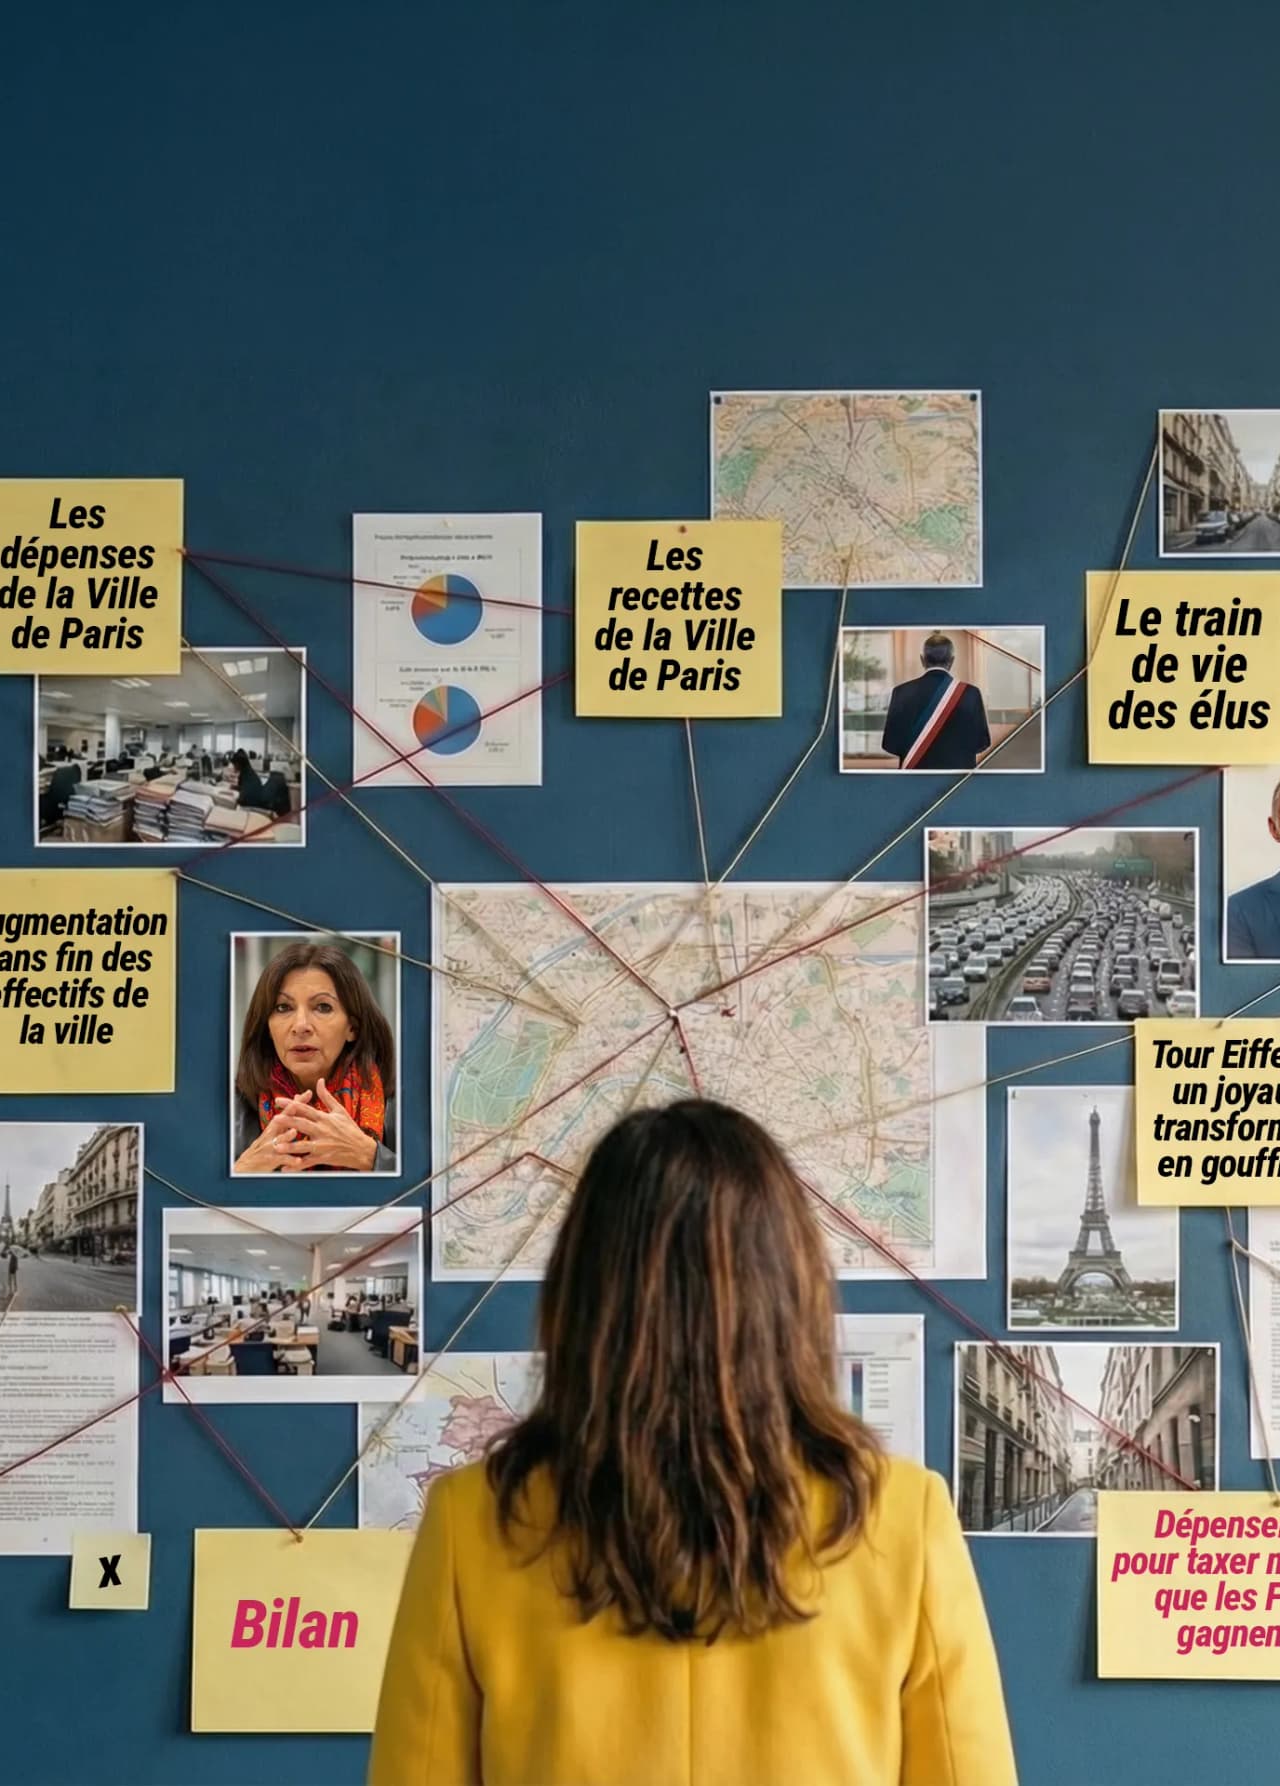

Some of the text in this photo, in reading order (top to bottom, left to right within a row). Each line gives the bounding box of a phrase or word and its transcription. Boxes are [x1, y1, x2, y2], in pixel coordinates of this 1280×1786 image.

[49, 497, 106, 529] Les
[0, 535, 156, 578] dépenses
[646, 539, 703, 571] Les
[45, 575, 75, 609] la
[87, 575, 158, 609] Ville
[607, 581, 742, 611] recettes
[11, 615, 144, 650] de Paris
[594, 617, 756, 651] de la Ville
[1115, 597, 1262, 637] Le train
[608, 657, 741, 691] de Paris
[1131, 643, 1248, 684] de vie
[1108, 688, 1271, 730] des élus
[55, 940, 93, 972] fin
[101, 940, 153, 972] des
[112, 977, 149, 1008] de
[19, 1014, 114, 1045] la ville
[1152, 1039, 1215, 1069] Tour
[1172, 1082, 1208, 1105] un
[1157, 1155, 1193, 1178] en
[1111, 1552, 1179, 1582] pour
[1187, 1548, 1260, 1575] taxer
[1154, 1588, 1207, 1618] que
[1214, 1580, 1257, 1611] les
[231, 1597, 358, 1649] Bilan
